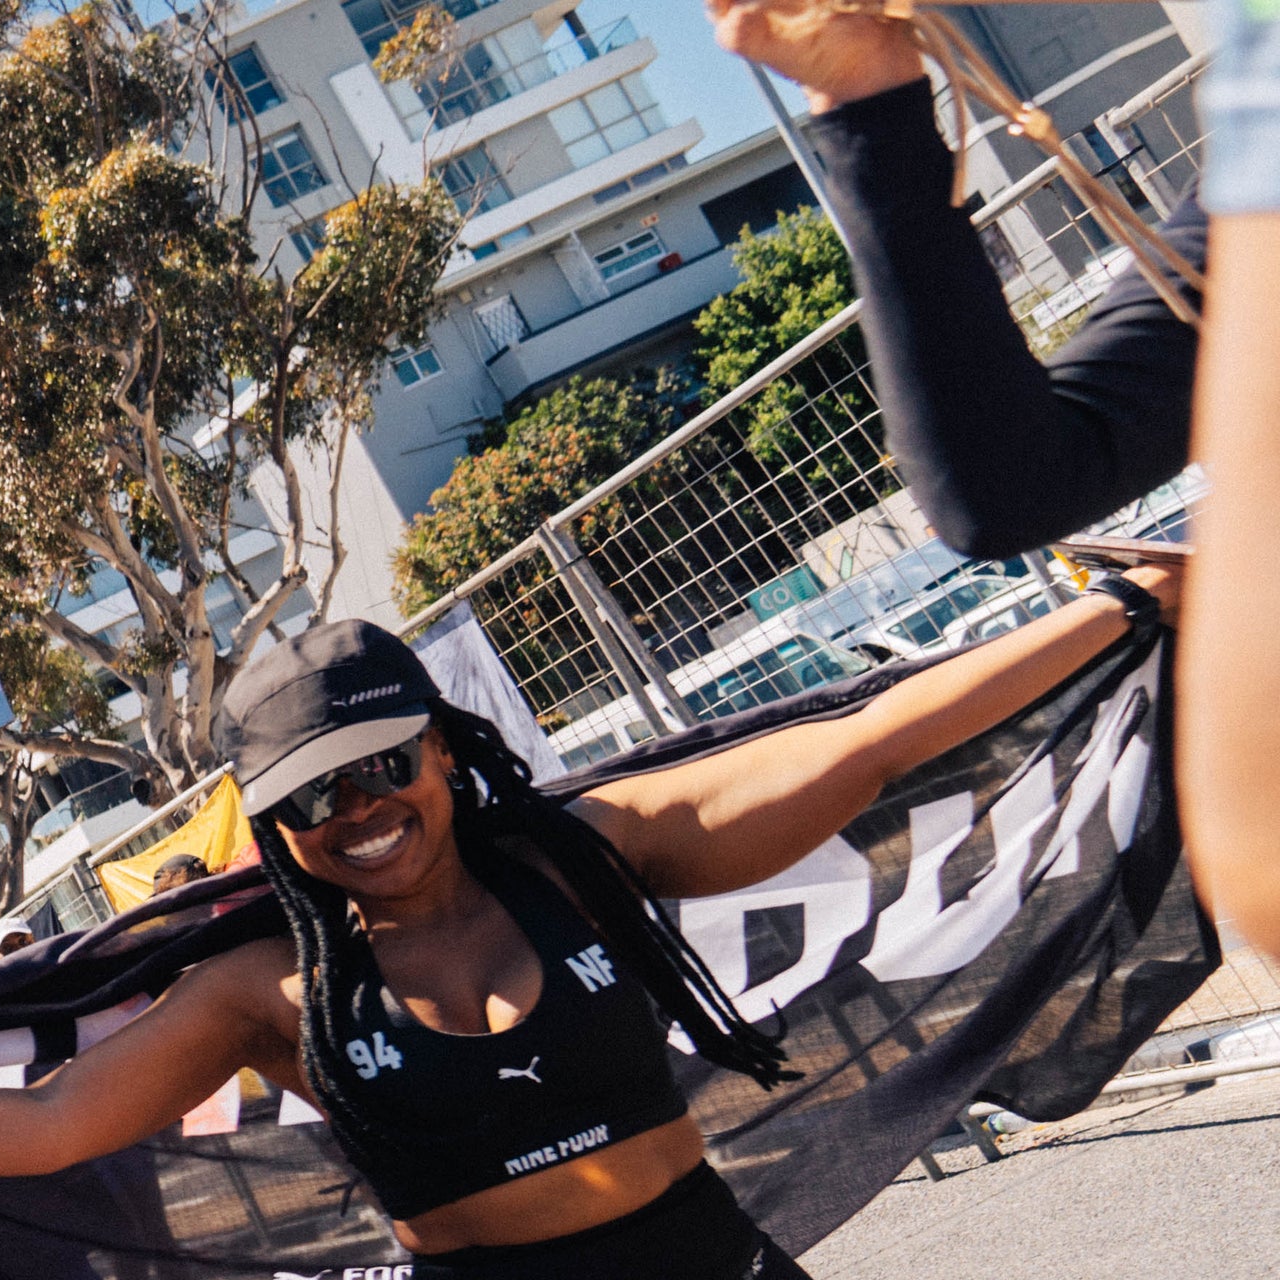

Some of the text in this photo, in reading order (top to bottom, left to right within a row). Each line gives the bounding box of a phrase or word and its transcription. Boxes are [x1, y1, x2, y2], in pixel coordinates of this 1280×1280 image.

[564, 943, 617, 993] NF
[346, 1031, 403, 1080] 94
[504, 1124, 609, 1175] NINE FOUR
